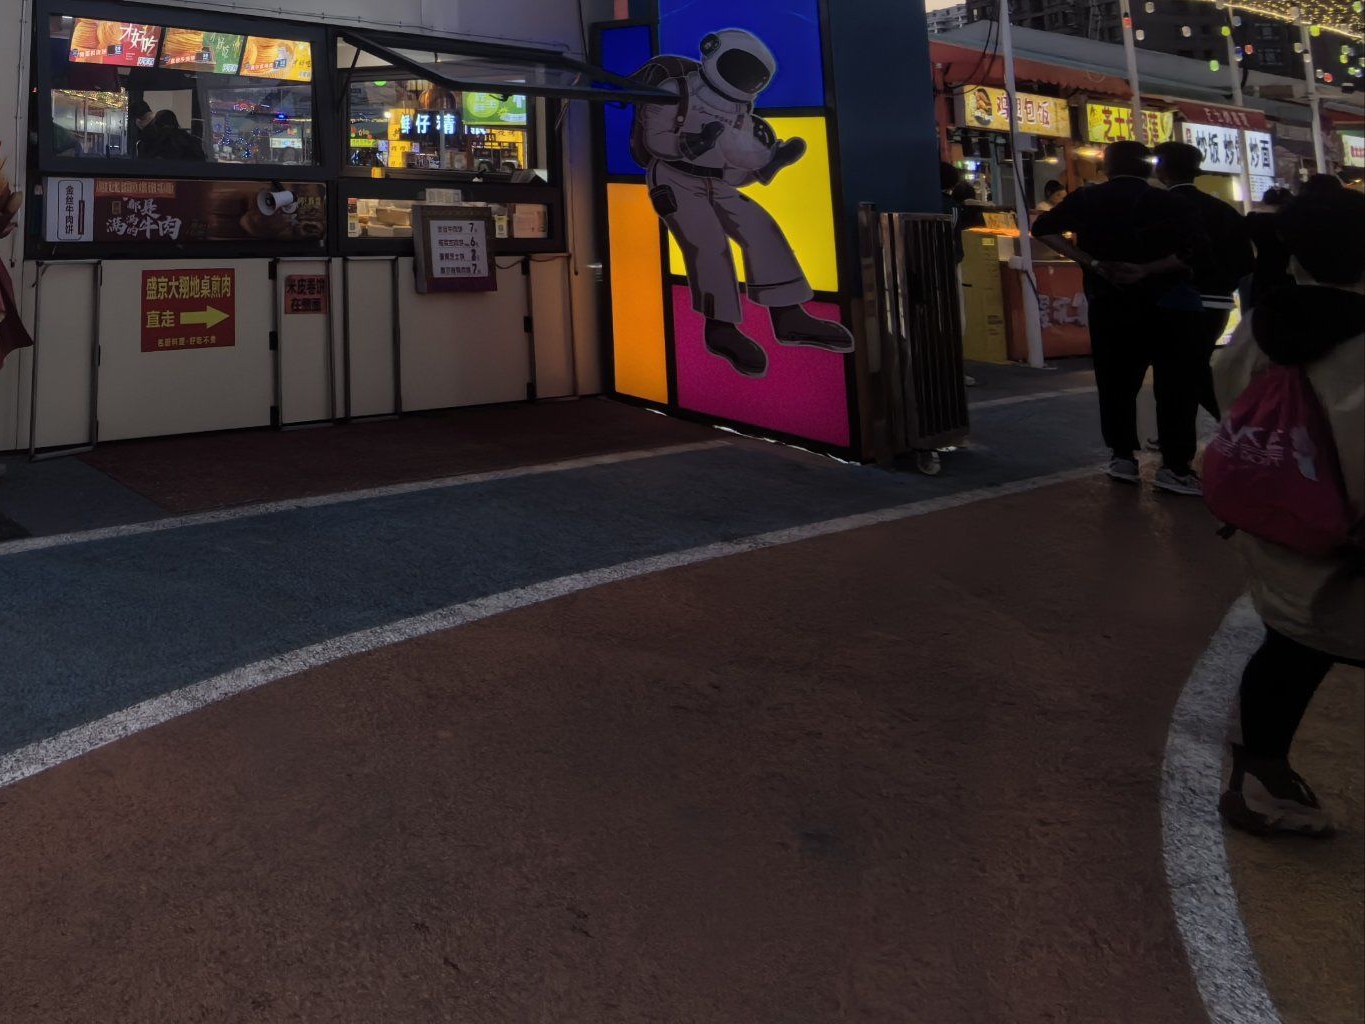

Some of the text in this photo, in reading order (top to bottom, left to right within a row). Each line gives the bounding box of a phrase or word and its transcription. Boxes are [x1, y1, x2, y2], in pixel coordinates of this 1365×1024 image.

[64, 184, 75, 236] 金丝牛肉饼
[145, 309, 176, 329] 直走
